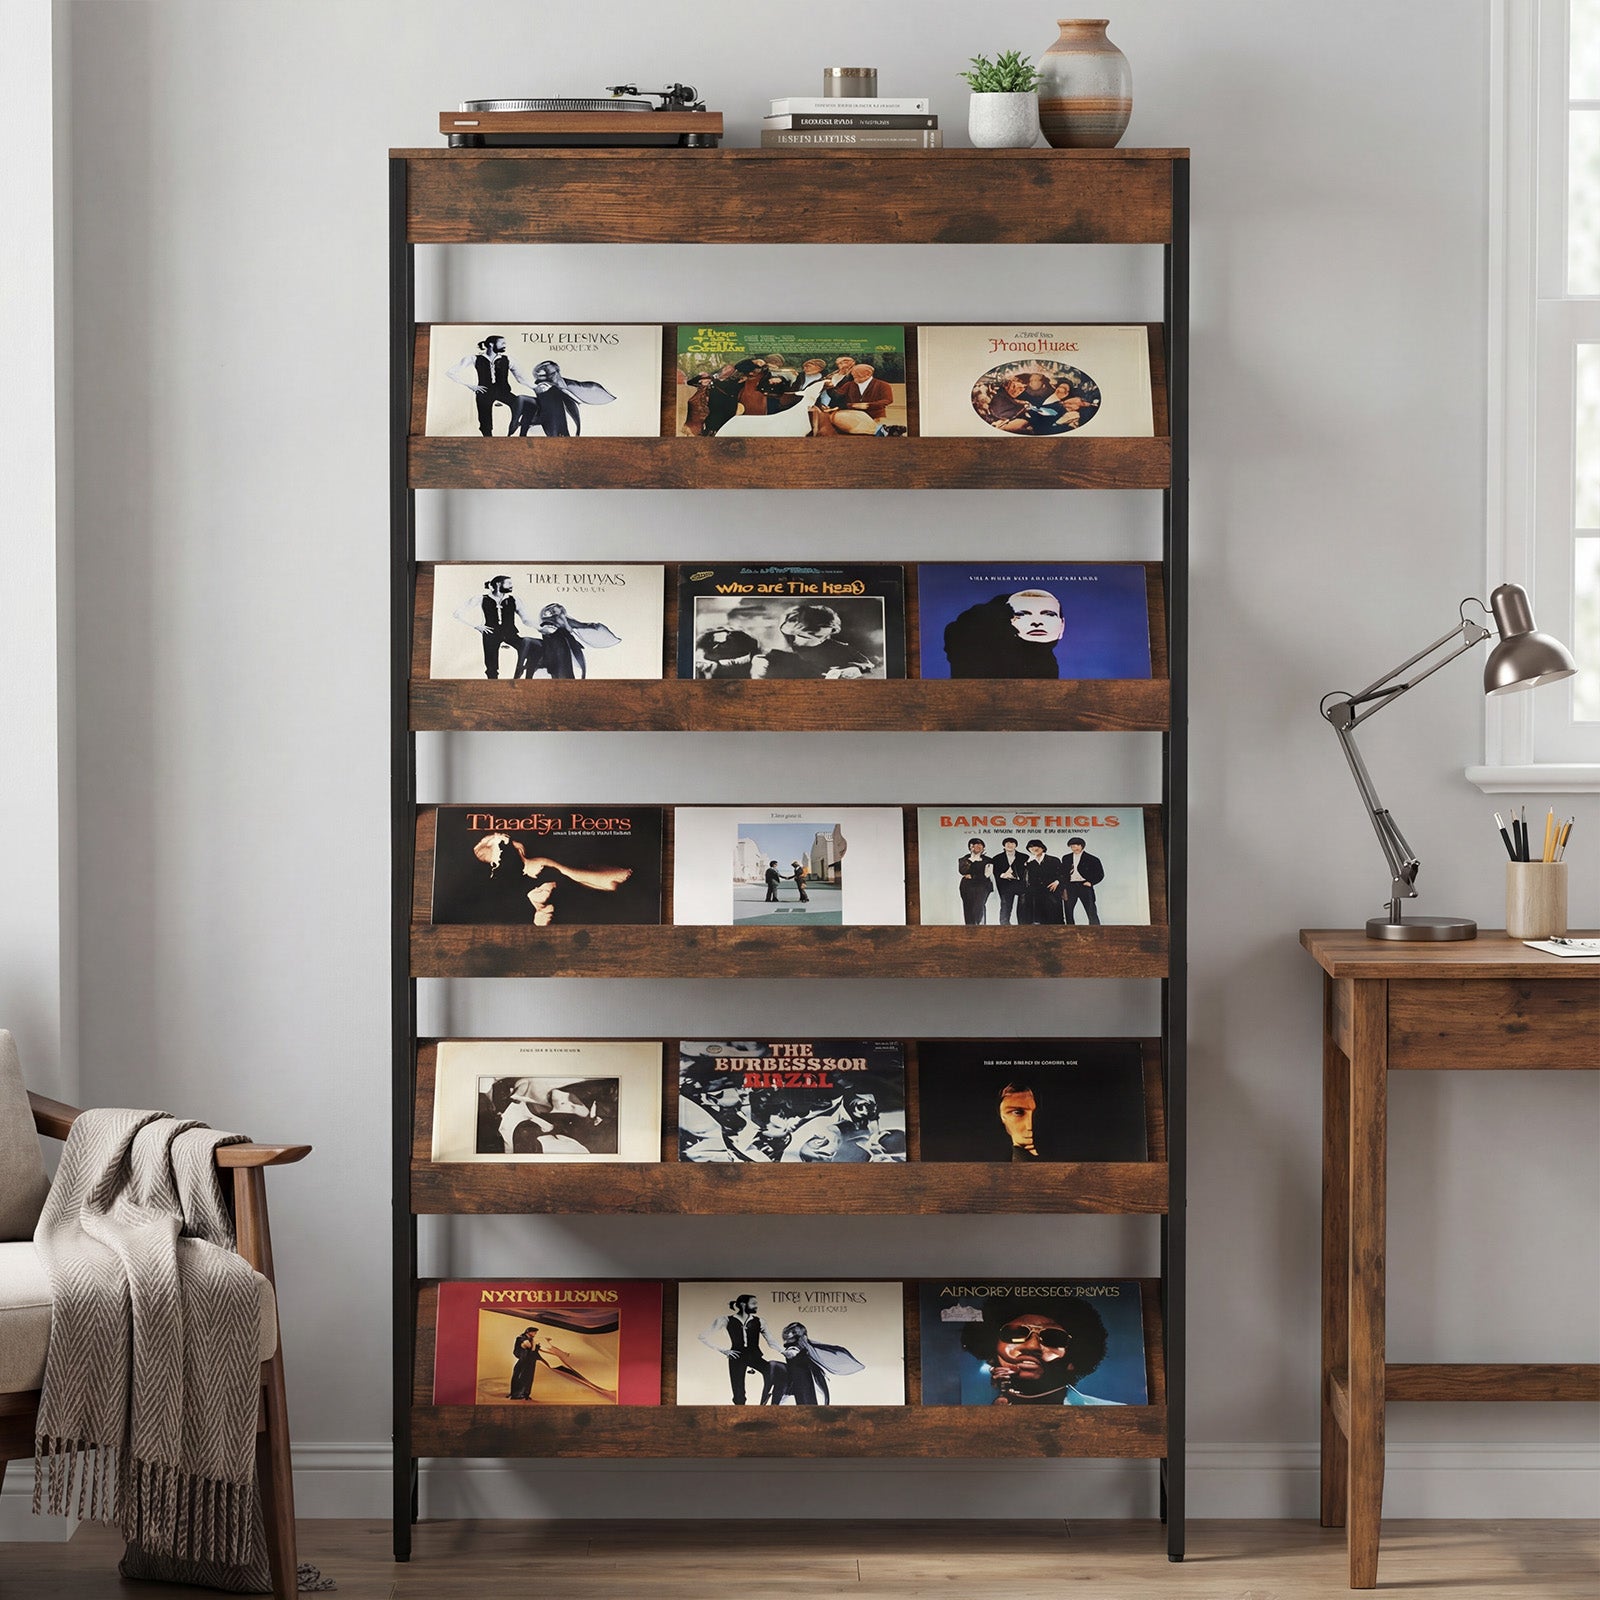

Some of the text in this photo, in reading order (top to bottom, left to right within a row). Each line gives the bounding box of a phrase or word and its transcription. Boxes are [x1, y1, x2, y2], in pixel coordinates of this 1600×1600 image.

[715, 581, 755, 594] Who
[757, 582, 784, 593] are
[939, 815, 1007, 828] BANG
[768, 1043, 814, 1057] THE
